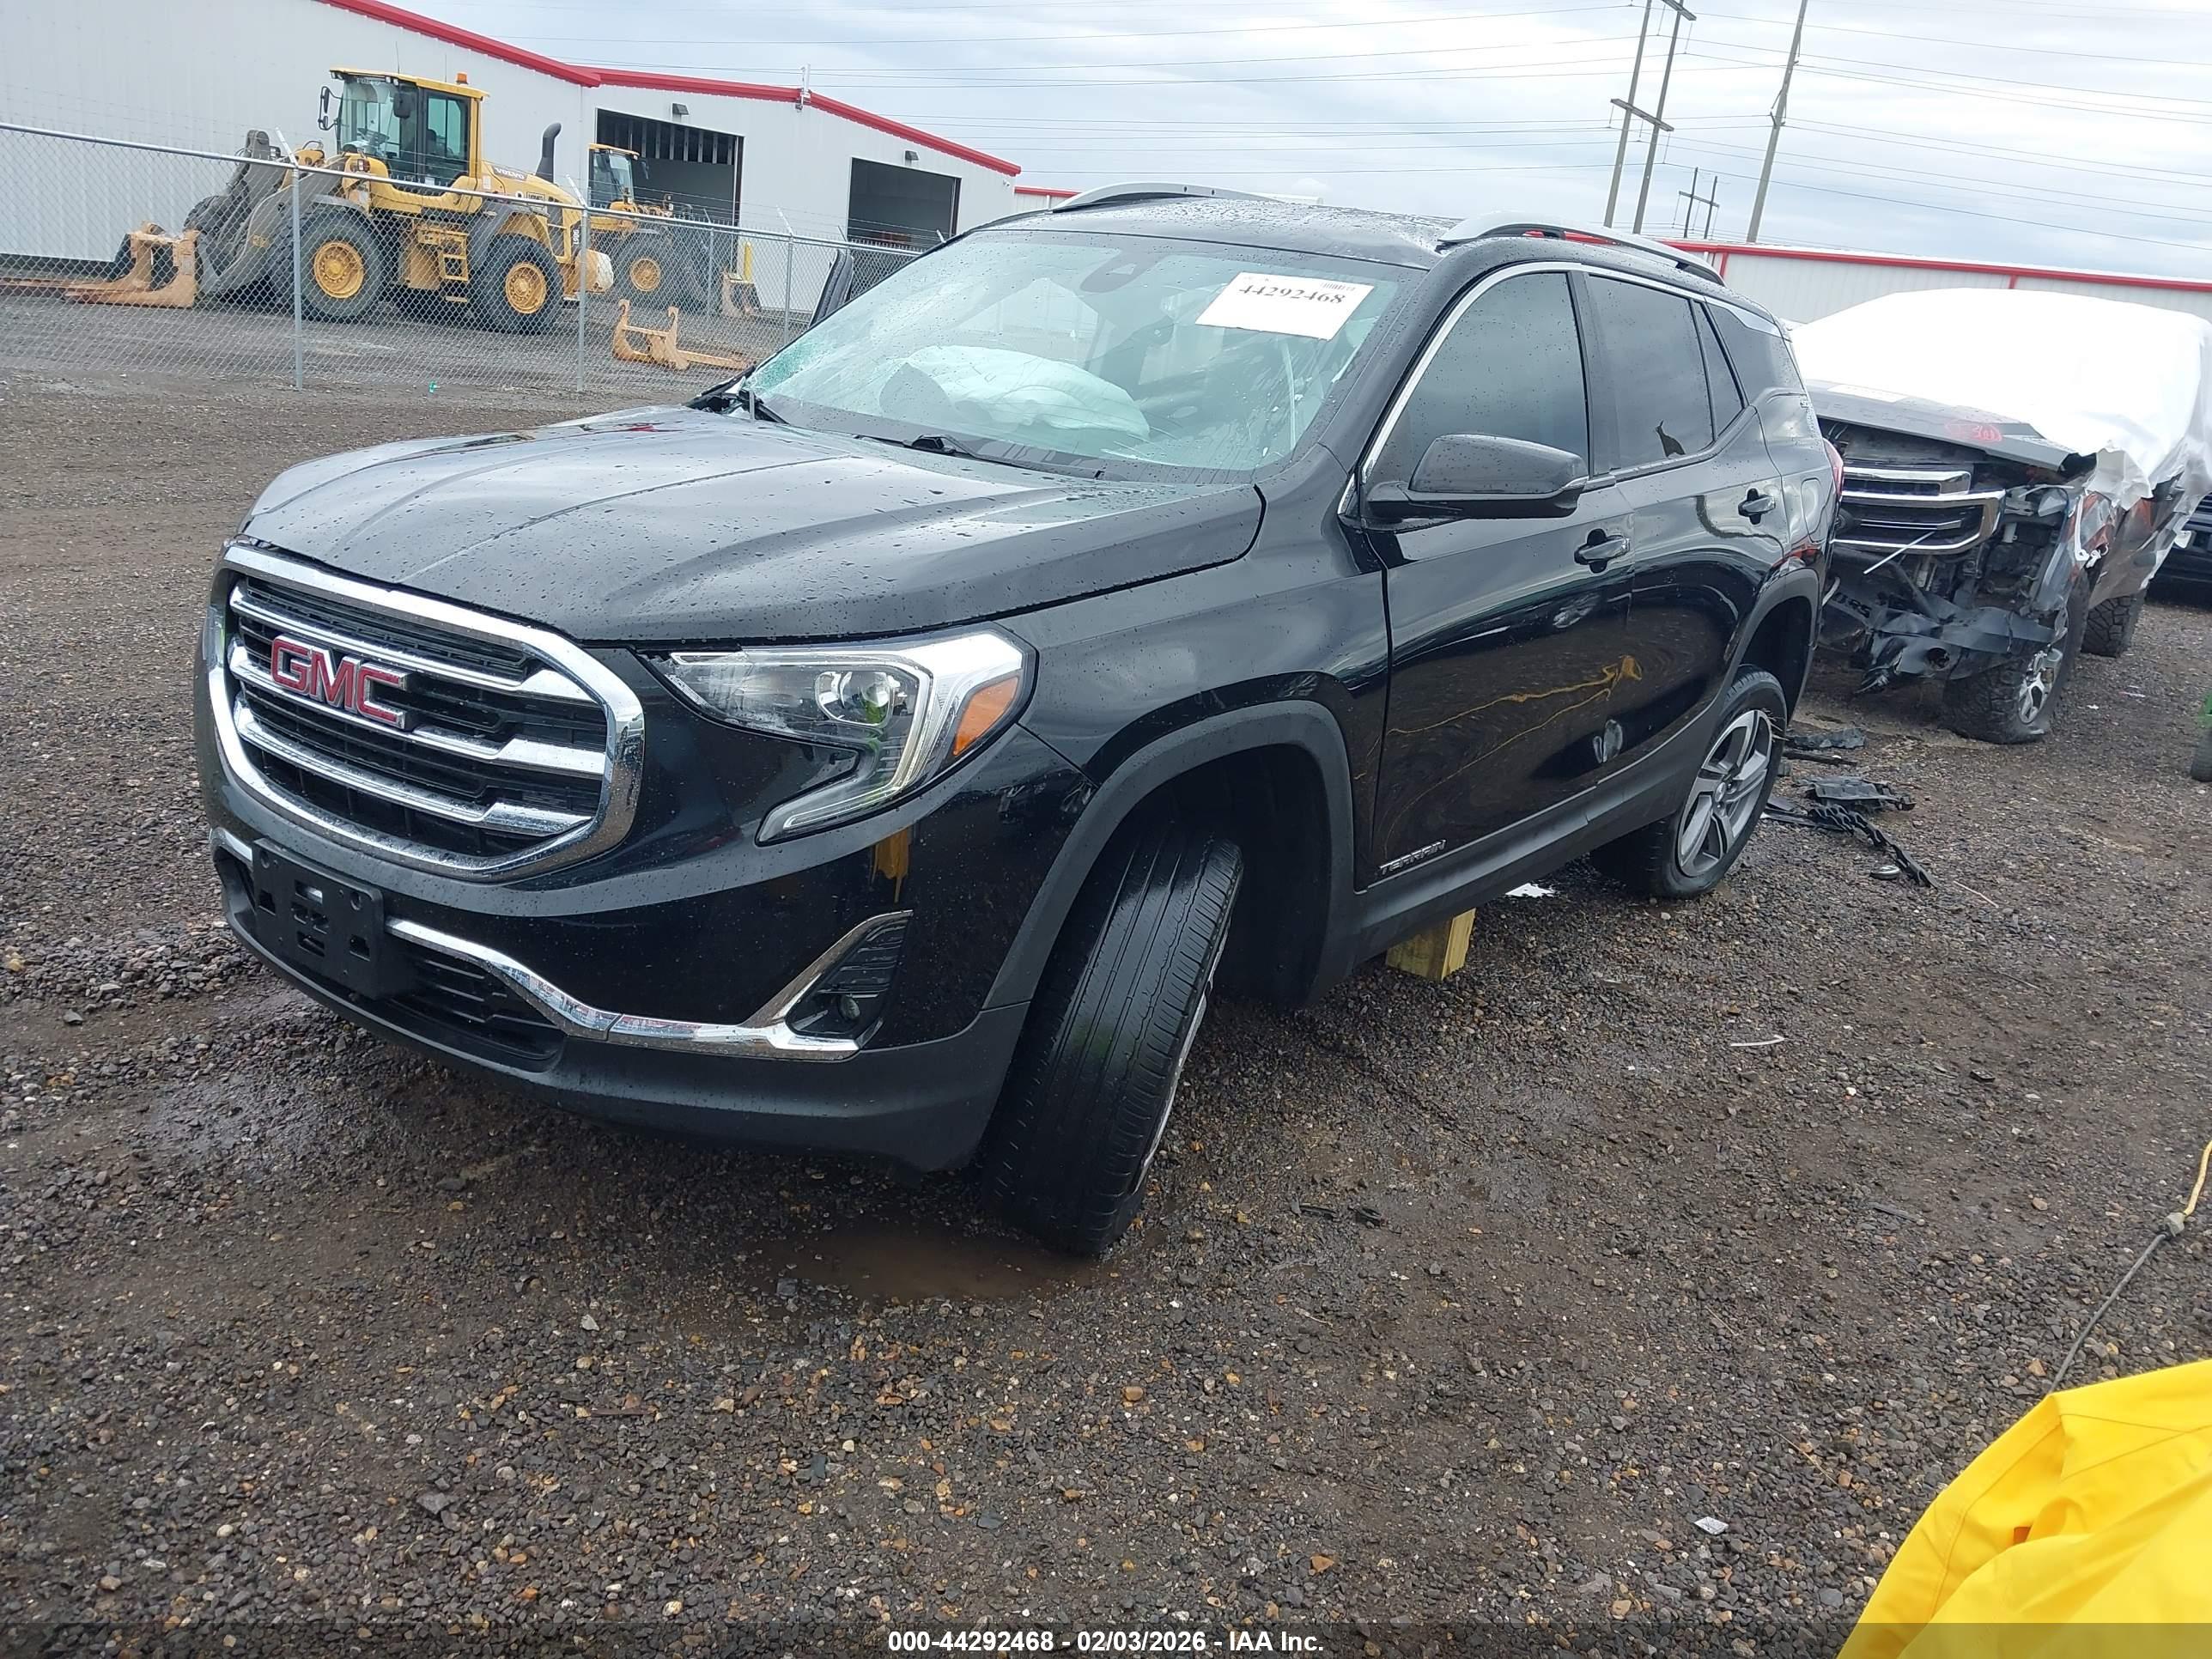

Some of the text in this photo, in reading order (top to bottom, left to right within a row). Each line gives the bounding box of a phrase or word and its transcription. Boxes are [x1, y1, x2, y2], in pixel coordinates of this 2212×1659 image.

[494, 167, 526, 180] VOLVO
[1239, 284, 1346, 304] 44292468
[271, 634, 408, 729] GMC
